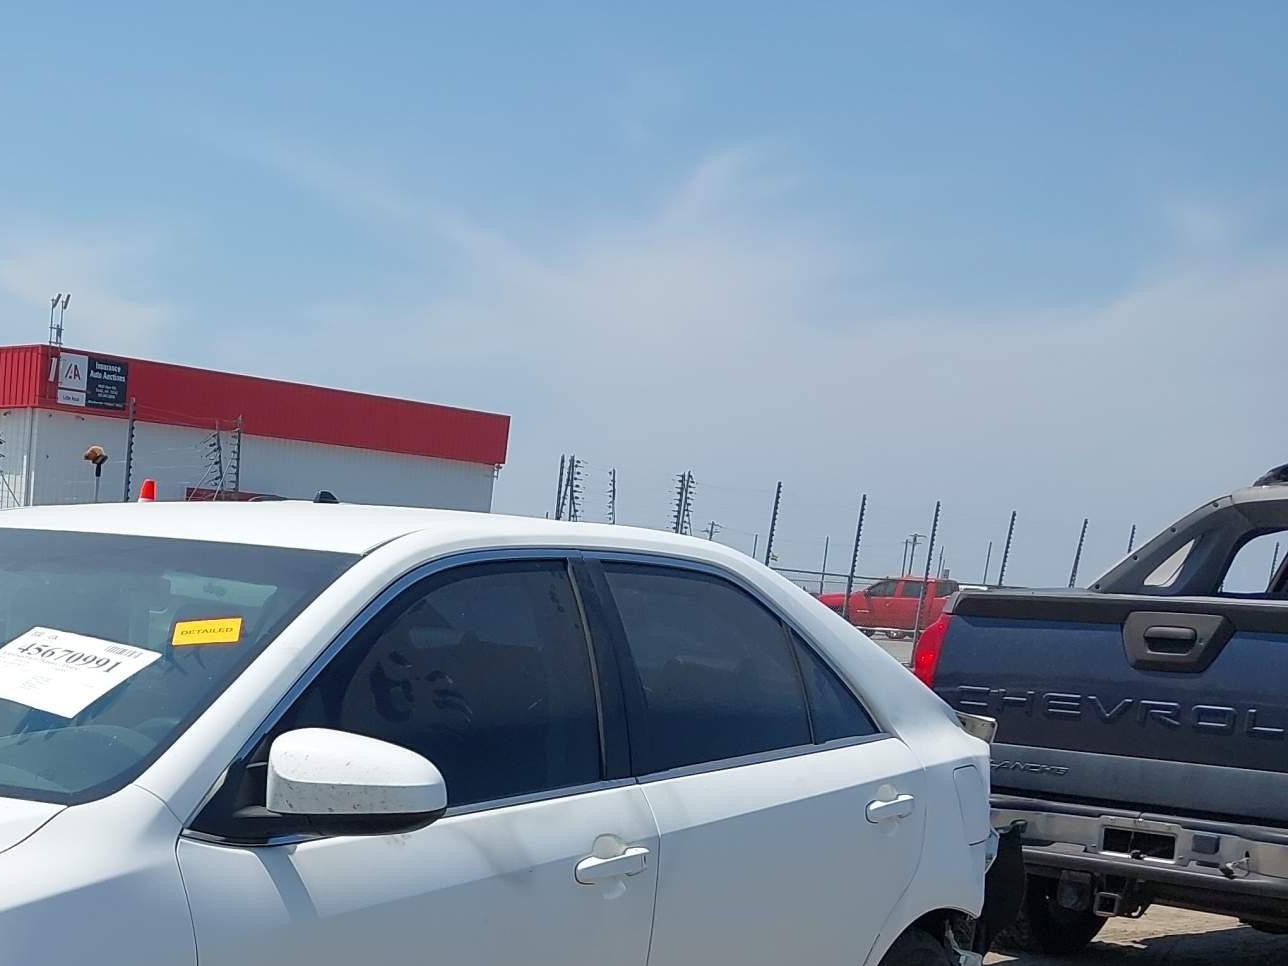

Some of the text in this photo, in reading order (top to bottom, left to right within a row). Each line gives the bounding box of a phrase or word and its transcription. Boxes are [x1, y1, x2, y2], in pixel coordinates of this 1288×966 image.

[90, 370, 126, 383] Auto Auctions
[181, 627, 234, 636] DETAILED
[17, 642, 121, 673] 45670991
